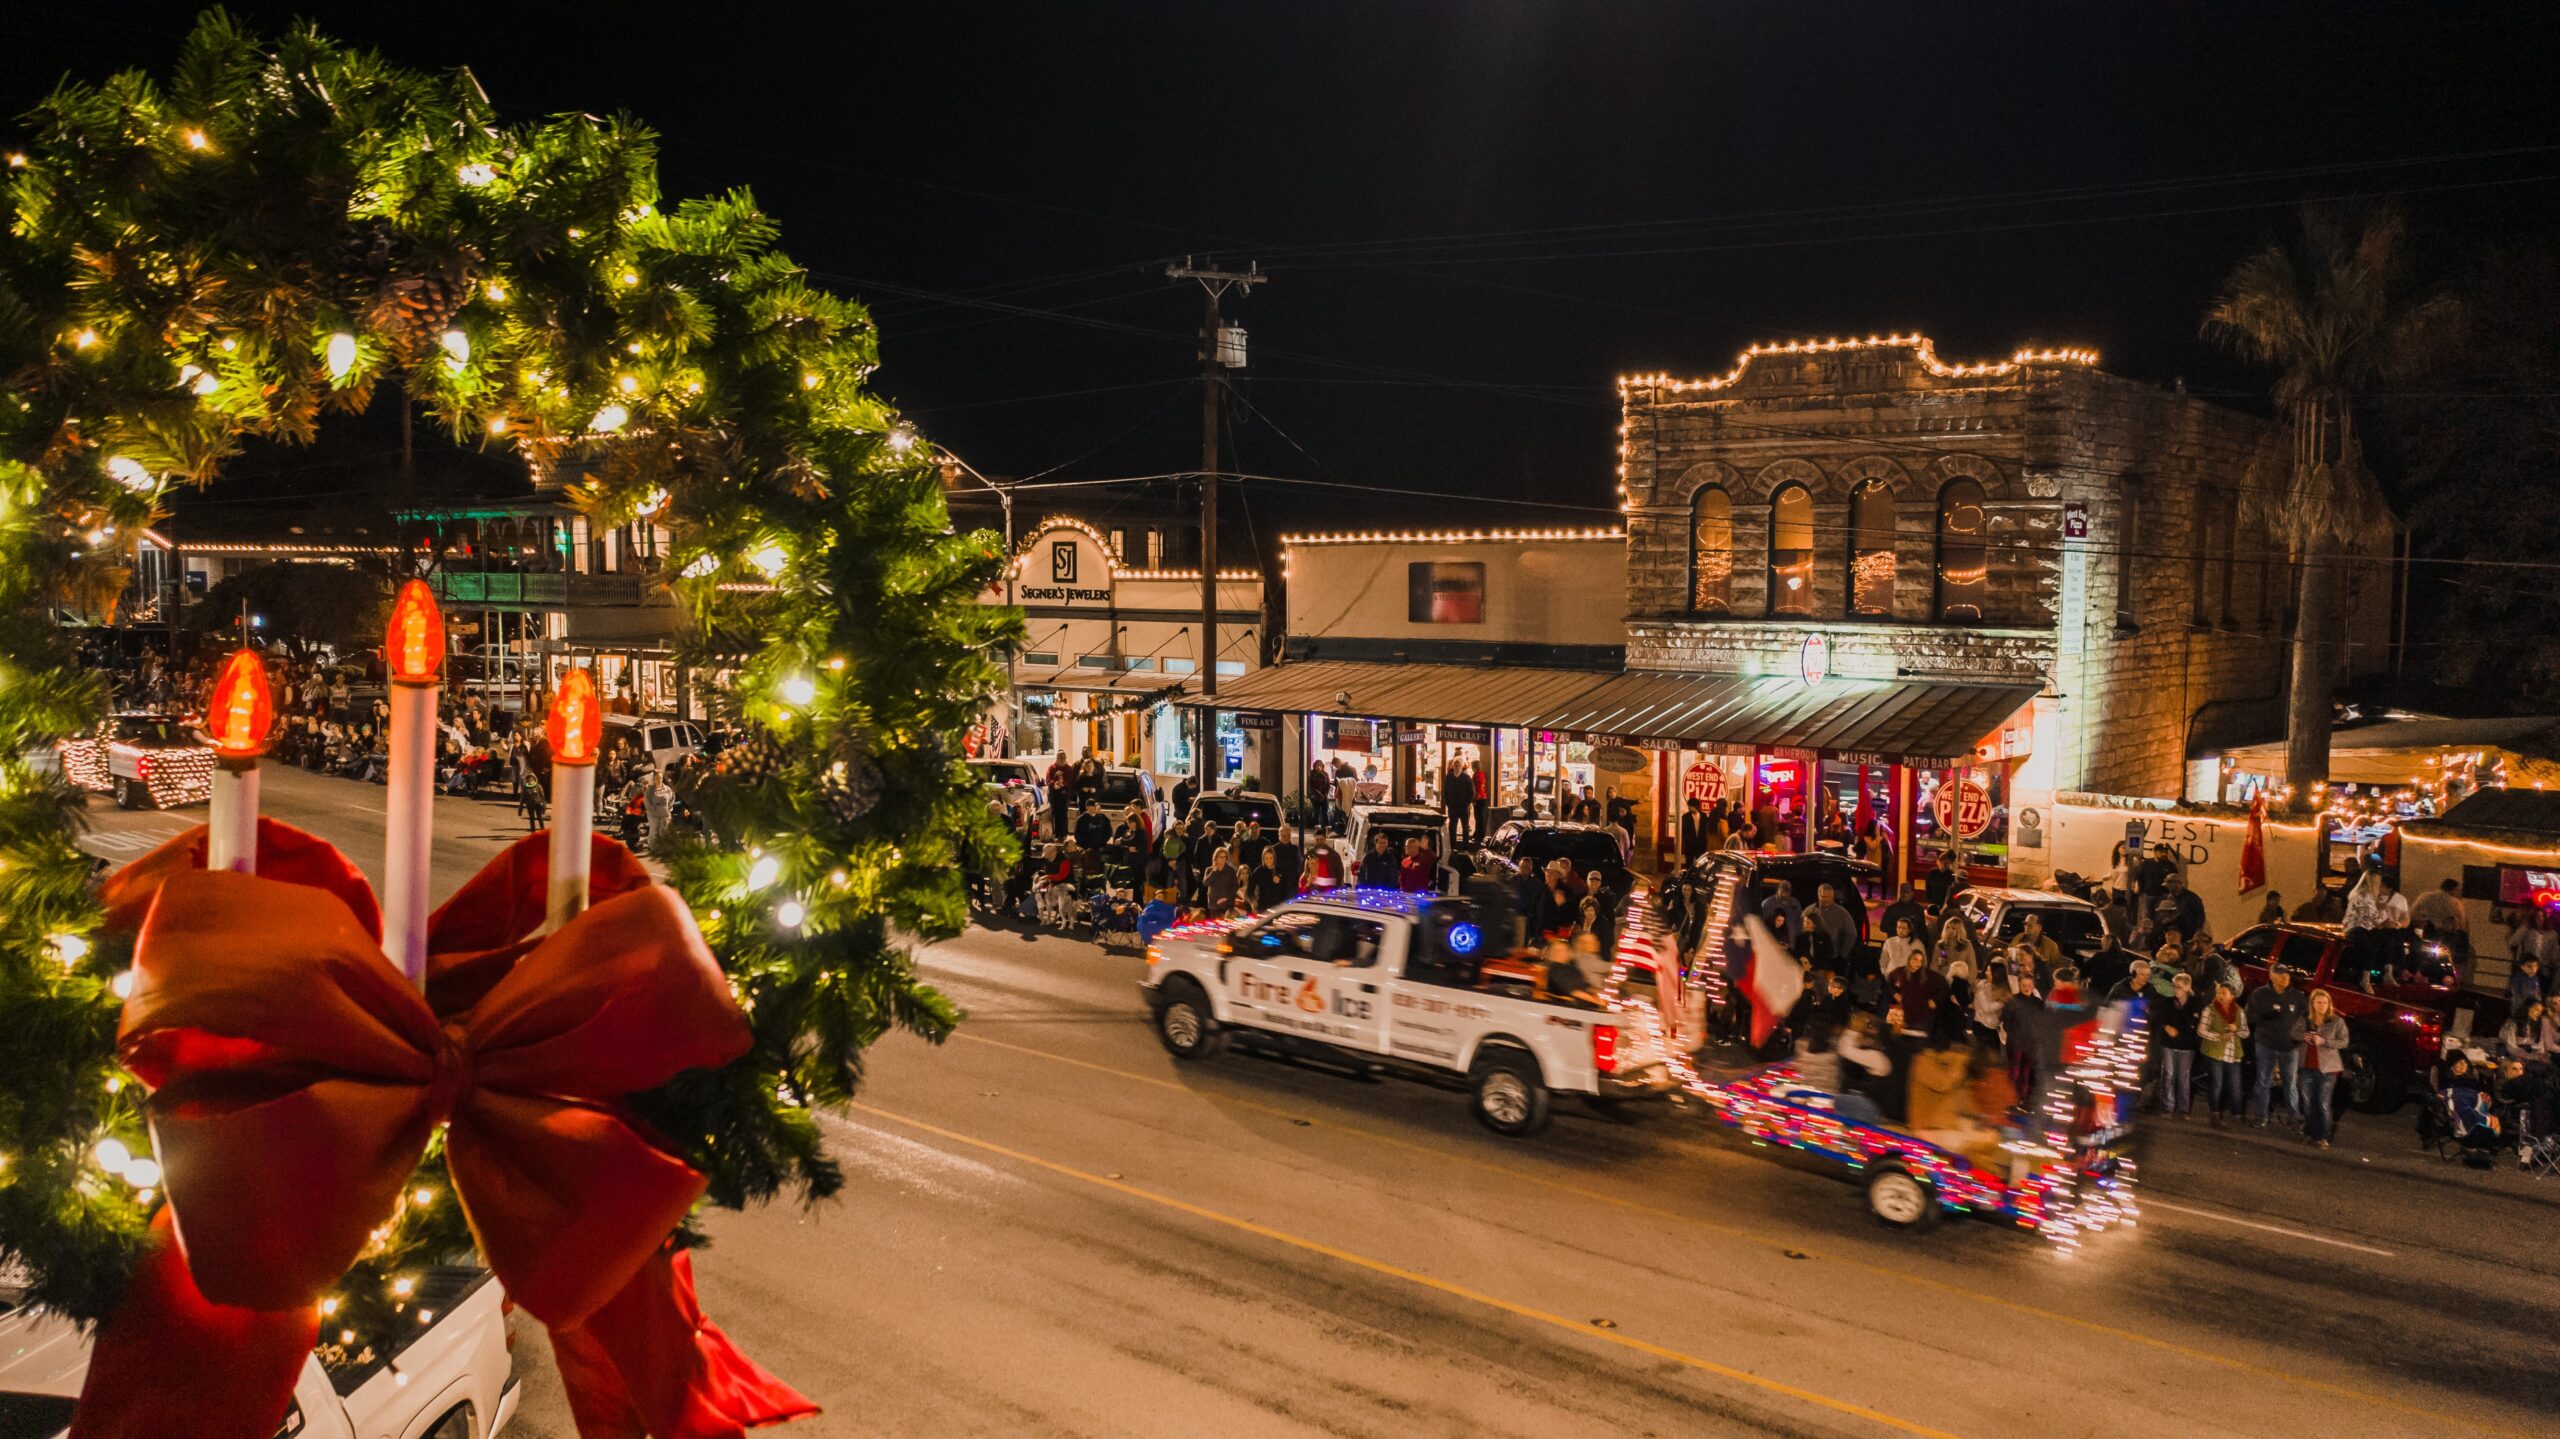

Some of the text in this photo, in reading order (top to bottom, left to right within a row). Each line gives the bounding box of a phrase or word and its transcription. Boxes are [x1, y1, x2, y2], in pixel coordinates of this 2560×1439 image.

[1057, 547, 1072, 577] SJ
[1065, 587, 1111, 605] JEWELERS
[1241, 718, 1275, 727] FINE ART
[1399, 733, 1423, 742] GALLERY
[1439, 730, 1487, 742] FINE CRAFT
[1587, 736, 1622, 748] PASTA
[1641, 739, 1678, 751] SALAD
[1714, 744, 1725, 754] OUT
[1727, 745, 1756, 756] DELIVERY
[1774, 748, 1817, 760] GAMEROOM
[1930, 758, 1950, 770] BAR
[1686, 771, 1719, 782] WEST END
[1766, 769, 1795, 784] OPEN
[1963, 792, 1980, 802] END
[1940, 800, 1989, 824] PZZA
[1240, 971, 1374, 1020] Fire Ice
